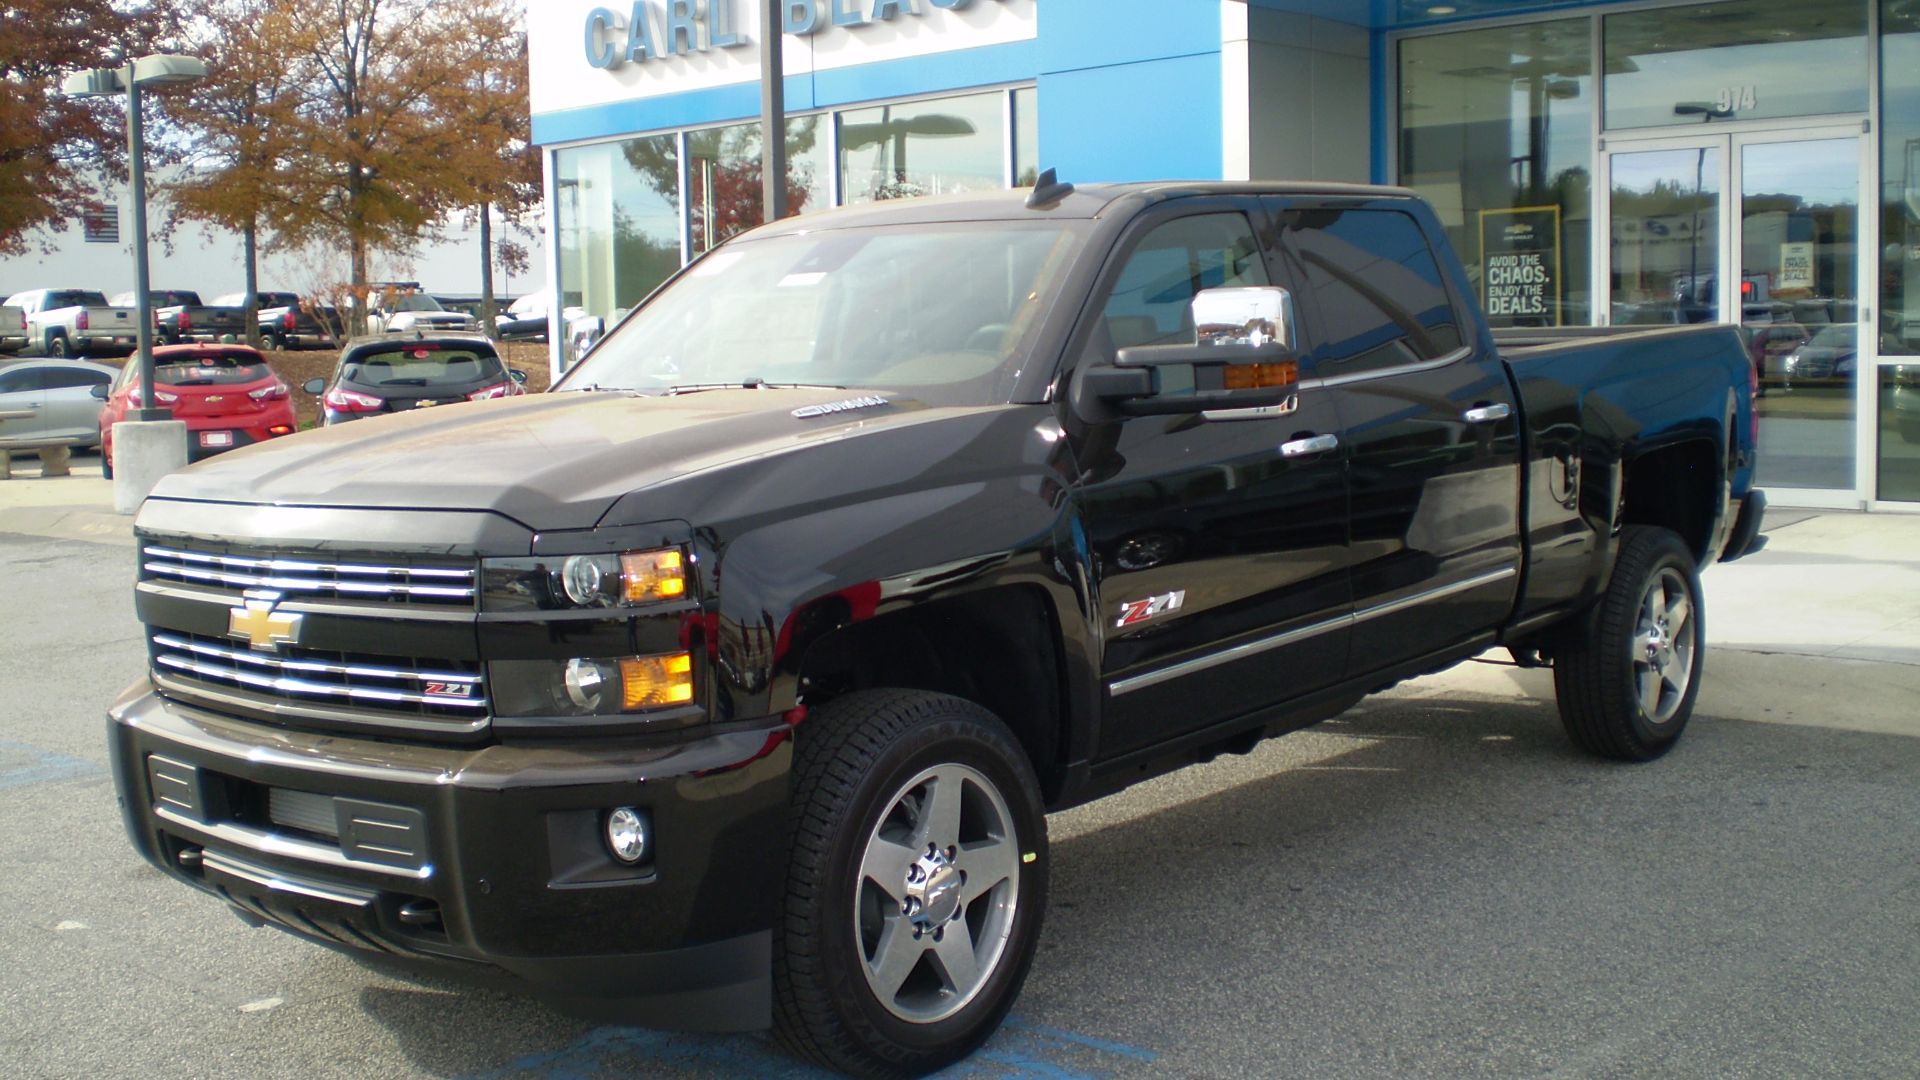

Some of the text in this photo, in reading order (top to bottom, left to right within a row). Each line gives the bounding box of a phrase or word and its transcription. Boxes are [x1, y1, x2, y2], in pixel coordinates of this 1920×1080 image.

[584, 0, 740, 70] CARL
[1717, 85, 1757, 112] 974
[1489, 254, 1540, 267] AVOID THE
[1489, 265, 1550, 284] CHAOS.
[1489, 284, 1543, 297] ENJOY THE
[1489, 296, 1548, 314] DEALS.
[1117, 590, 1185, 627] Z71
[424, 681, 471, 698] Z71
